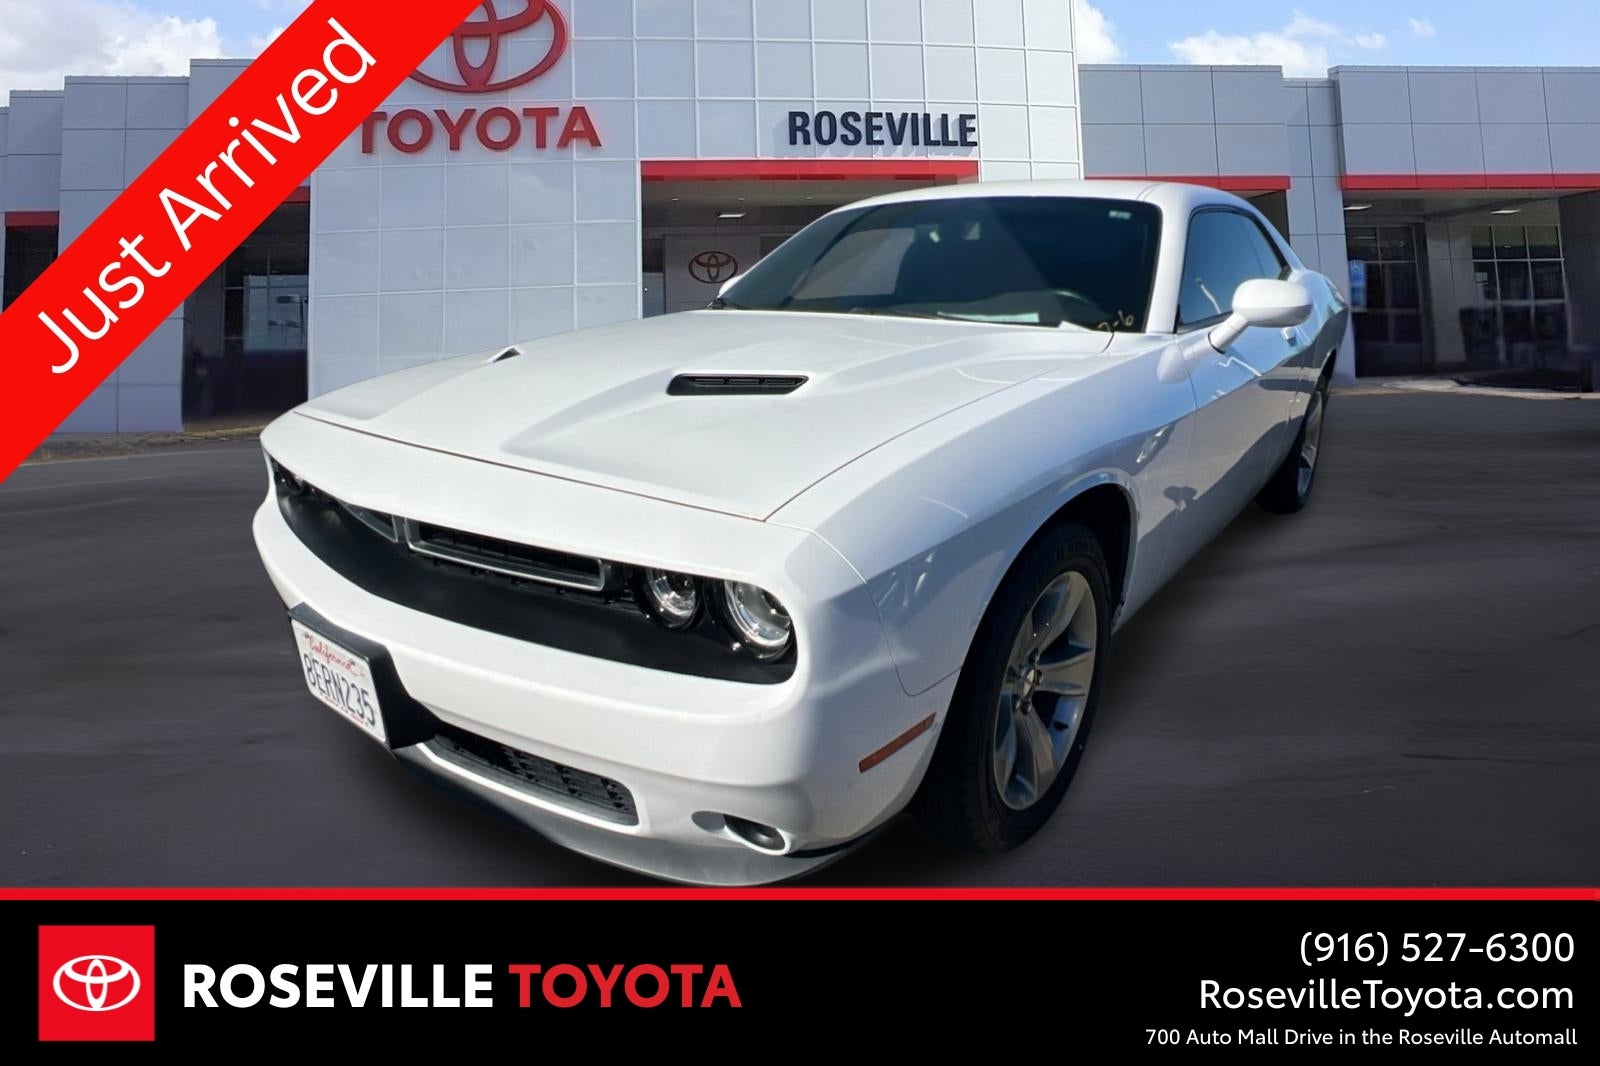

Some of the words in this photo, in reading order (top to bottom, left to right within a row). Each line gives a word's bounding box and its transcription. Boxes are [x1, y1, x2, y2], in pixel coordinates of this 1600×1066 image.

[361, 106, 602, 154] TOYOTA
[788, 110, 978, 147] ROSEVILLE
[303, 653, 376, 728] 8ERN235
